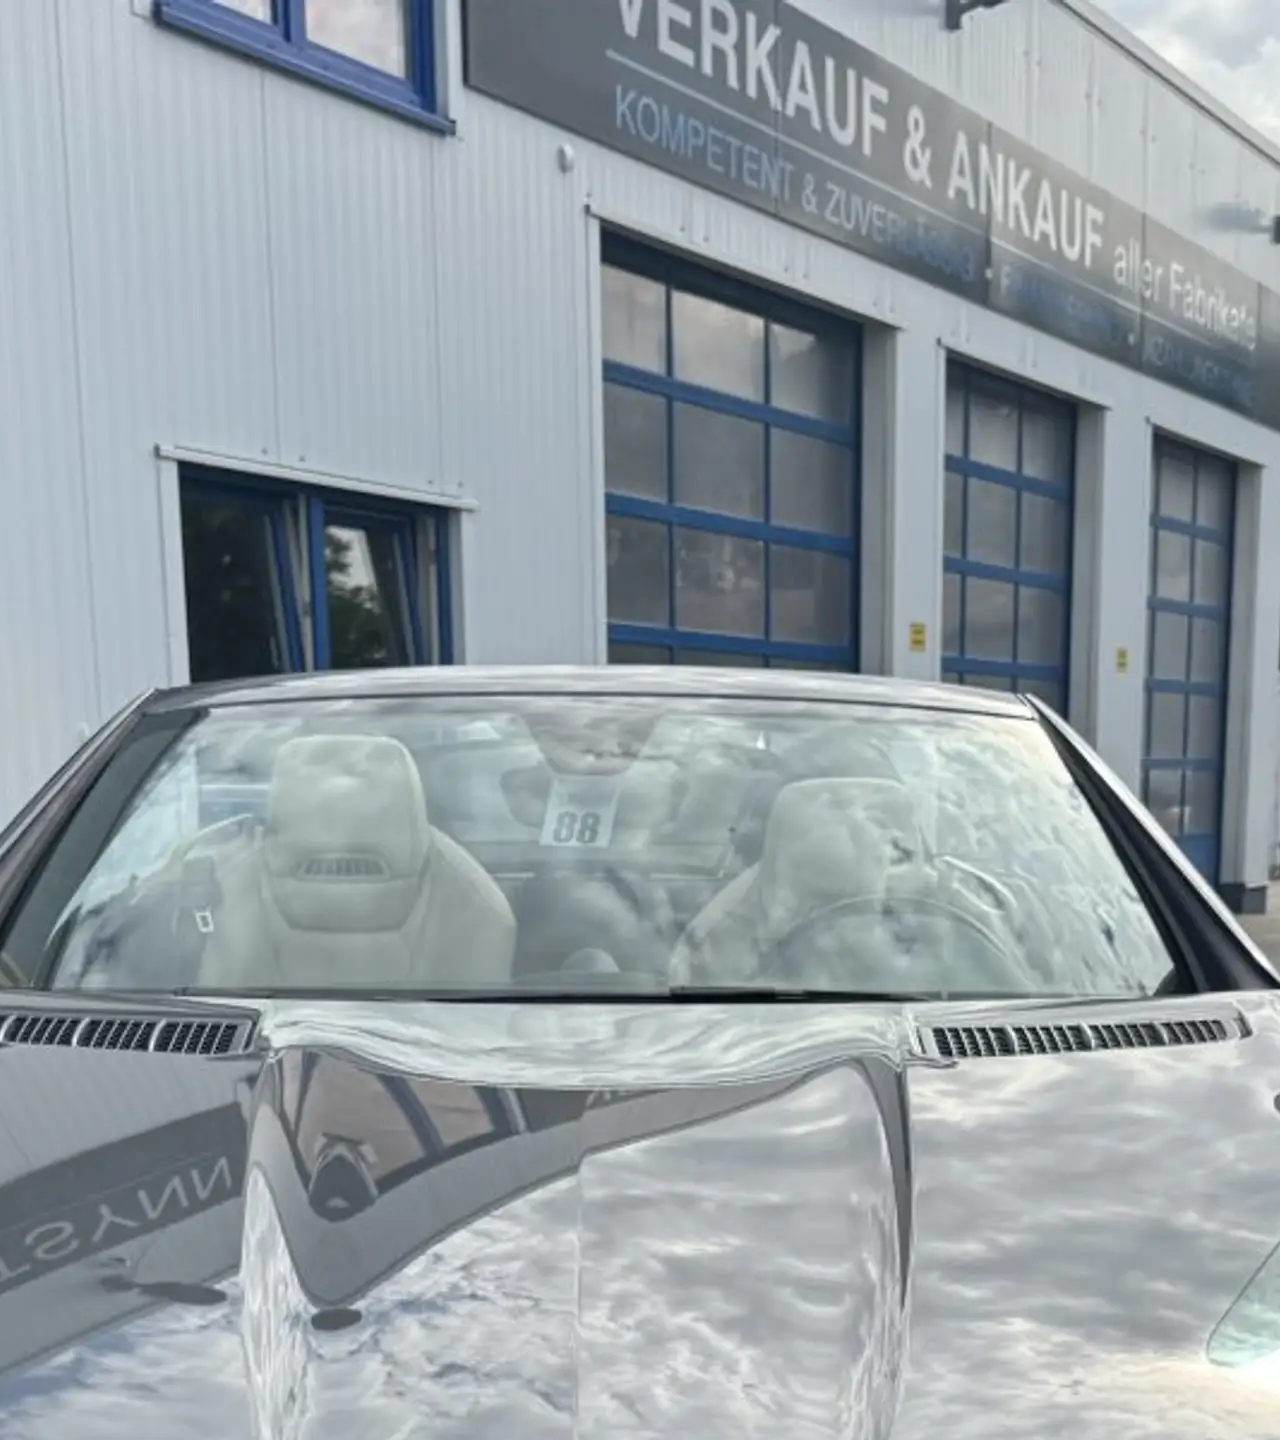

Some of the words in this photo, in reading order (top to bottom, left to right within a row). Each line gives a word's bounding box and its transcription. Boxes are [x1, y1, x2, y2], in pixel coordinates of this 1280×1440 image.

[616, 84, 794, 202] KOMPETENT
[801, 172, 819, 214] &
[903, 105, 932, 189] &
[947, 131, 1105, 269] ANKAUF
[1113, 237, 1164, 302] aller
